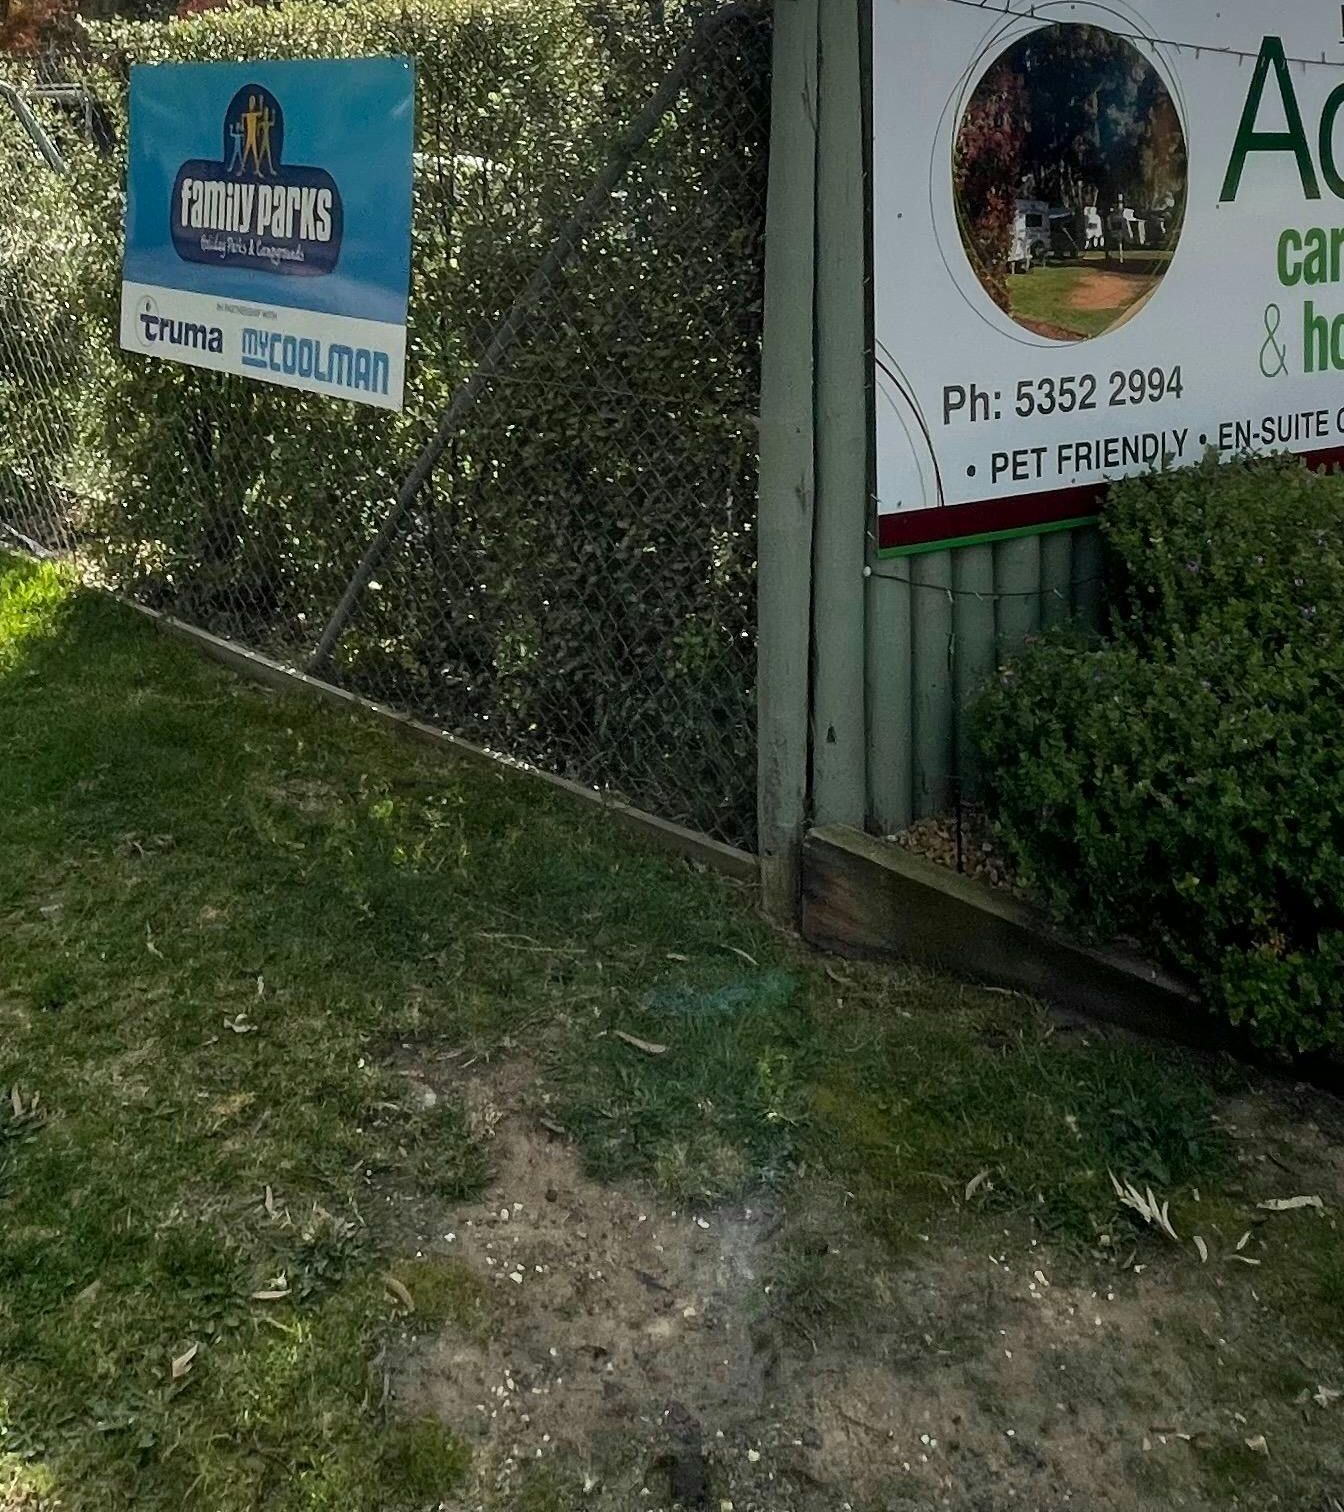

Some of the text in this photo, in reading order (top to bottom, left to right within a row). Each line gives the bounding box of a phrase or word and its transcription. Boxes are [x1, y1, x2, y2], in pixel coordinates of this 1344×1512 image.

[181, 177, 255, 233] family
[140, 313, 223, 354] truma
[1259, 302, 1289, 377] &
[943, 365, 1184, 425] Ph: 5352 2994
[991, 447, 1047, 484] PET
[1057, 428, 1188, 475] FRIENDLY
[1218, 409, 1329, 450] EN-SUITE
